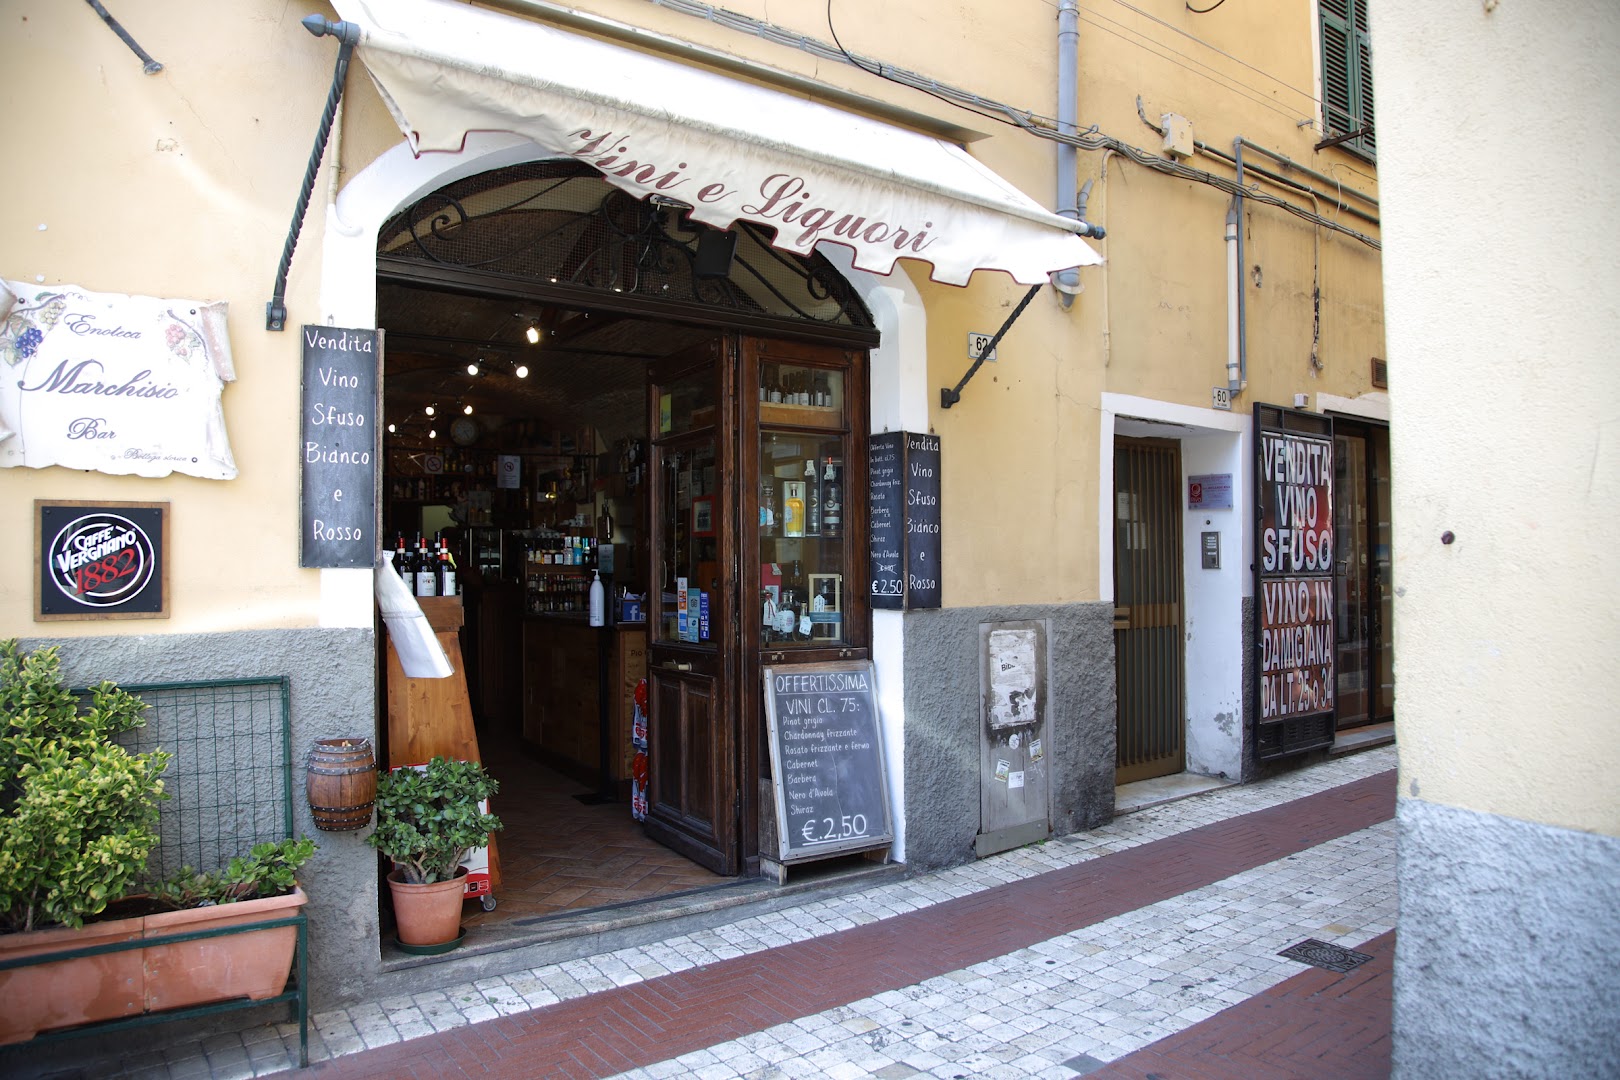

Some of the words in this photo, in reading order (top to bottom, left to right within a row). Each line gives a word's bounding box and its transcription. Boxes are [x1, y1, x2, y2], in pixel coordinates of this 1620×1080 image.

[567, 129, 691, 190] Vini
[697, 182, 737, 204] e
[741, 173, 939, 253] Liquori
[63, 313, 142, 339] Enoteca
[305, 330, 372, 353] Vendita
[17, 359, 179, 399] Marchisio
[319, 366, 359, 389] Vino
[1217, 390, 1226, 403] 60
[311, 402, 365, 427] Sfuso
[66, 417, 117, 440] Bar
[306, 441, 370, 465] Bianco
[1262, 437, 1331, 486] VENDITA
[911, 462, 933, 477] Vino
[334, 488, 343, 502] e
[908, 488, 936, 505] Sfuso
[870, 506, 889, 515] Barbera
[1277, 484, 1317, 528] VINO
[313, 519, 362, 541] Rosso
[870, 520, 891, 529] Cabernet
[56, 530, 137, 573] VERGNANO
[870, 550, 881, 558] Nero
[920, 551, 925, 561] e
[1262, 527, 1331, 571] SFUSO
[74, 548, 137, 596] 1882
[909, 574, 935, 590] Rosso
[1263, 581, 1310, 625] VINO
[1314, 581, 1333, 621] IN
[1262, 624, 1332, 672] DAMIGIANA
[775, 674, 869, 693] OFFERTISSIMA
[1262, 675, 1277, 718] DA
[1280, 672, 1295, 715] LT.
[1298, 670, 1310, 712] 25
[1321, 667, 1334, 708] 34
[785, 698, 811, 714] VINI
[817, 698, 836, 714] CL.
[840, 698, 860, 712] 75:
[782, 716, 801, 726] Pinot
[803, 716, 823, 729] grigio
[784, 729, 825, 742] Chardonnay
[826, 728, 858, 738] frizzante
[785, 744, 808, 755] Rosato
[810, 743, 842, 753] frizzante
[851, 742, 870, 750] fermo
[786, 759, 818, 770] Cabernet
[787, 774, 817, 785] Barbera
[789, 790, 806, 800] Nero
[808, 787, 834, 799] d'Avola
[790, 804, 815, 816] Shiraz
